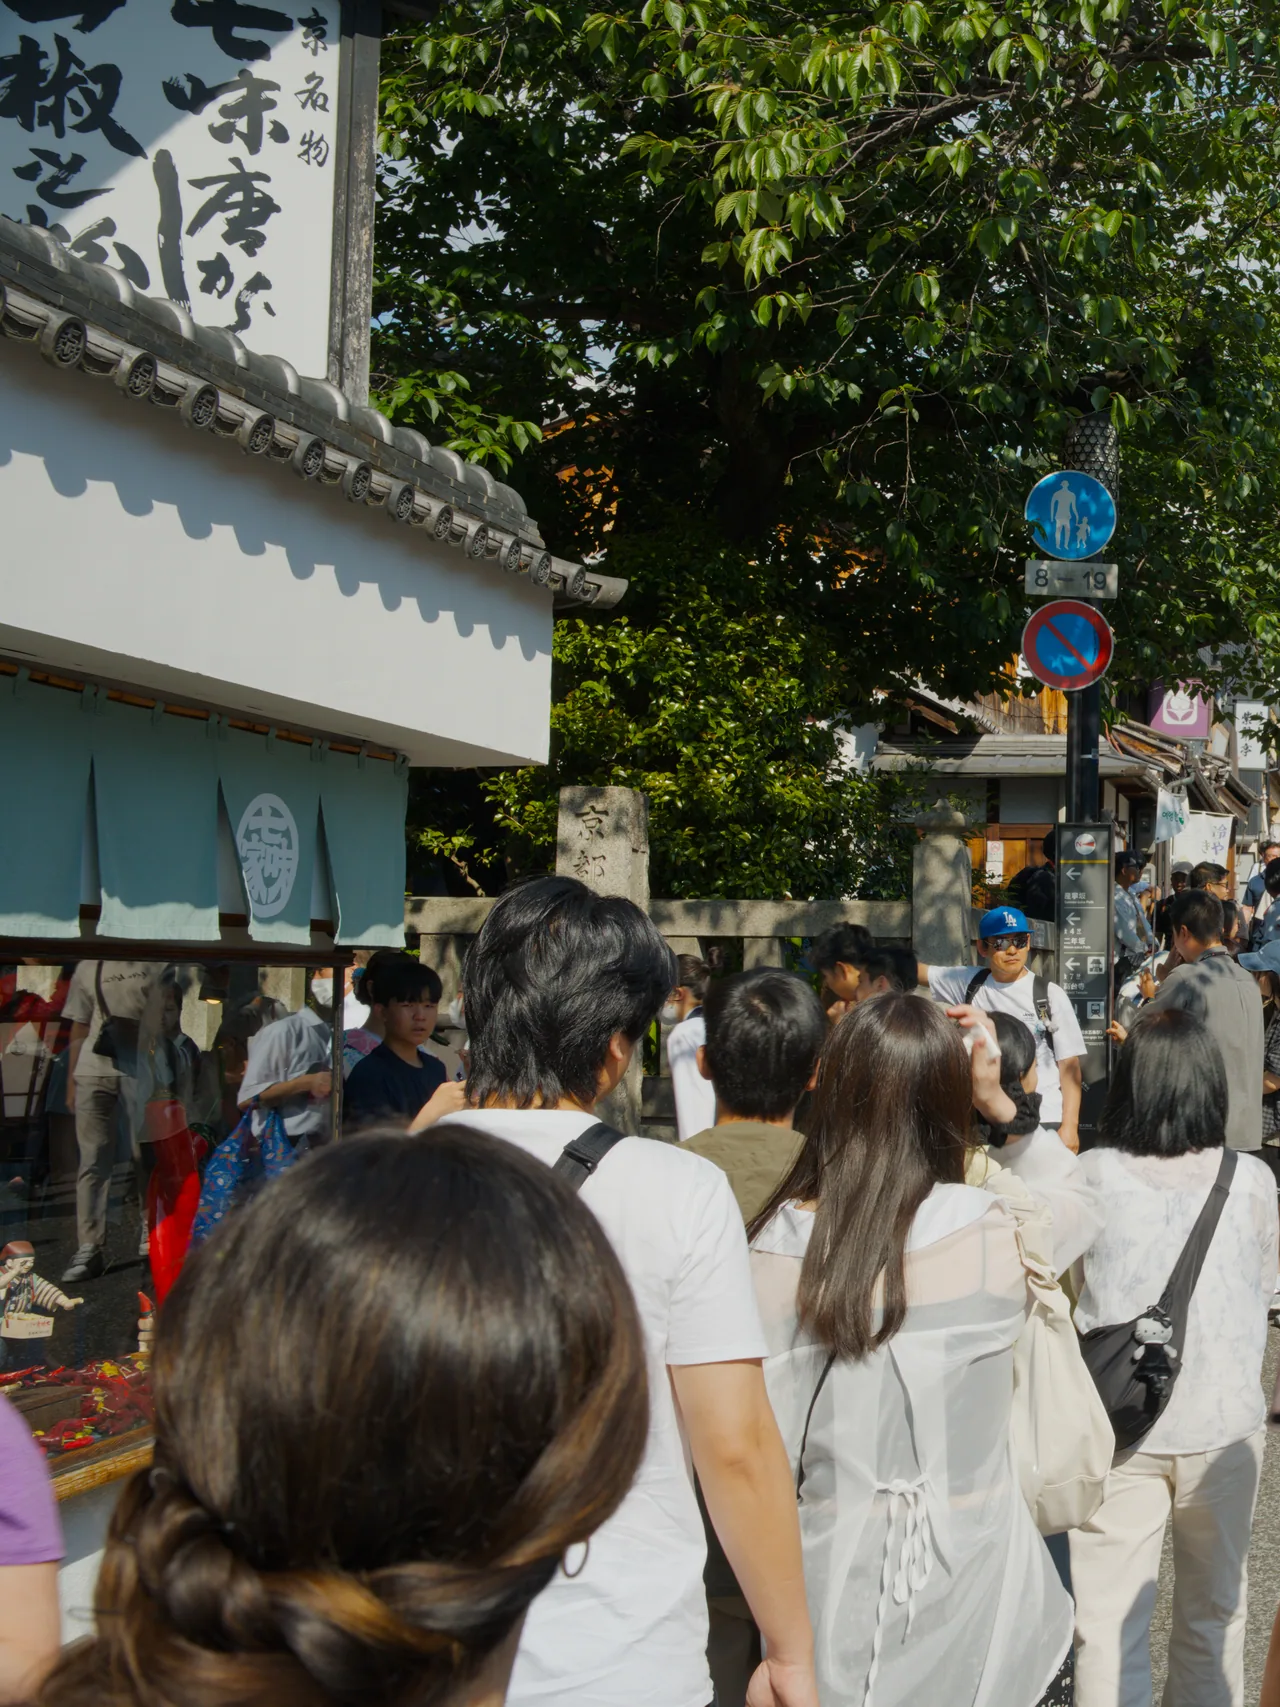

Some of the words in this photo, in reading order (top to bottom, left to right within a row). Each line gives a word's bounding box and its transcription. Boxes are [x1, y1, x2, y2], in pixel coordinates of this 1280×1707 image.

[295, 7, 330, 167] 京名物
[1035, 569, 1049, 588] 8
[1082, 571, 1107, 590] 19
[573, 804, 610, 885] 京都
